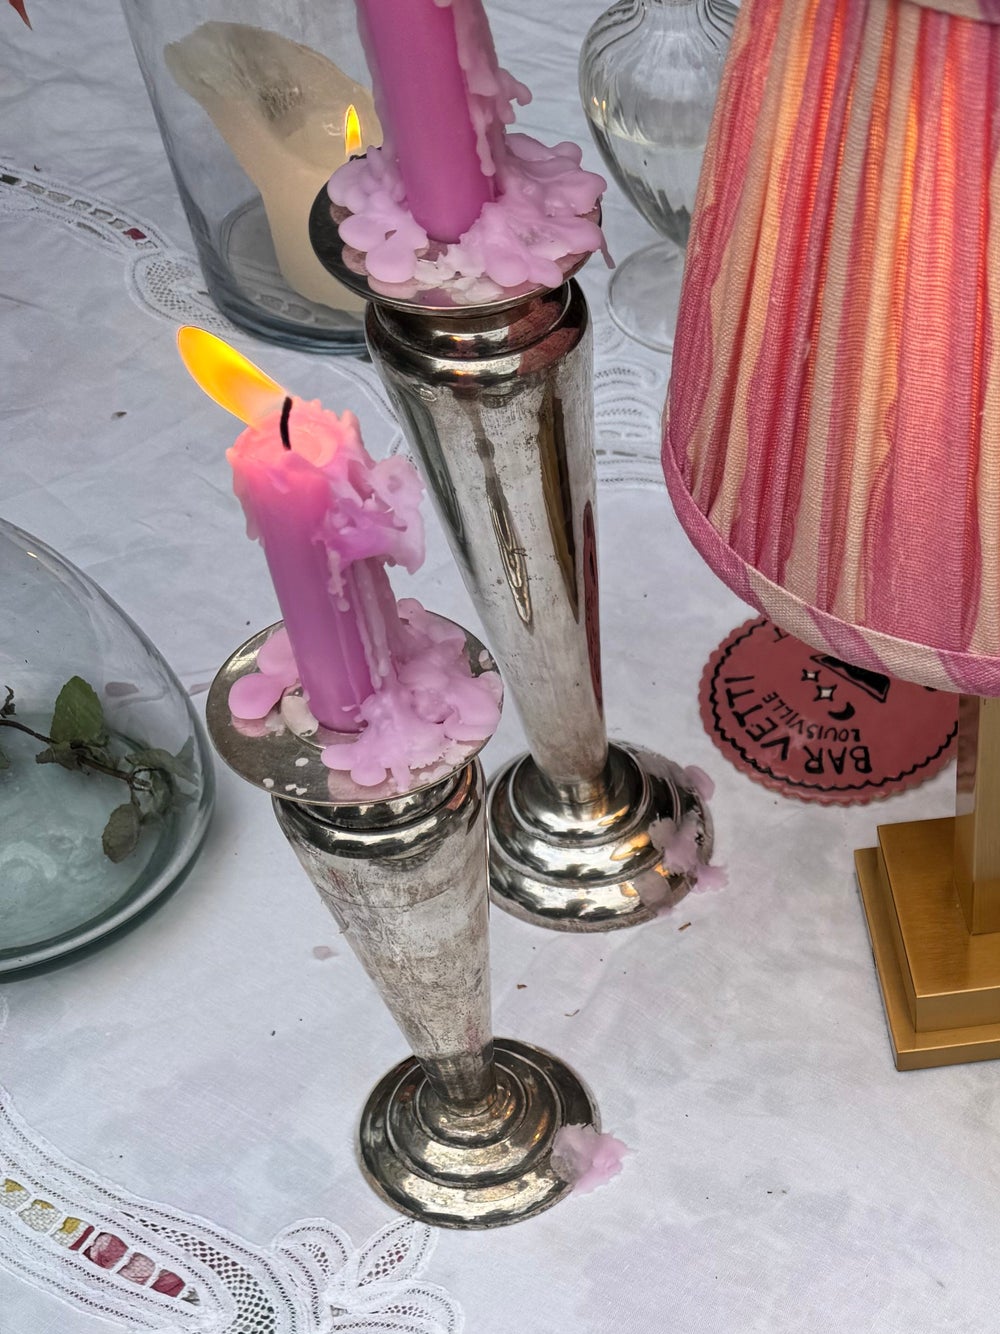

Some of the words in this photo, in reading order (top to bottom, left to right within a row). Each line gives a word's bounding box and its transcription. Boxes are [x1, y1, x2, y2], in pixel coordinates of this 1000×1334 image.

[724, 675, 791, 761] VETTI
[761, 691, 861, 743] LOUISVILLE
[803, 745, 873, 775] BAR
